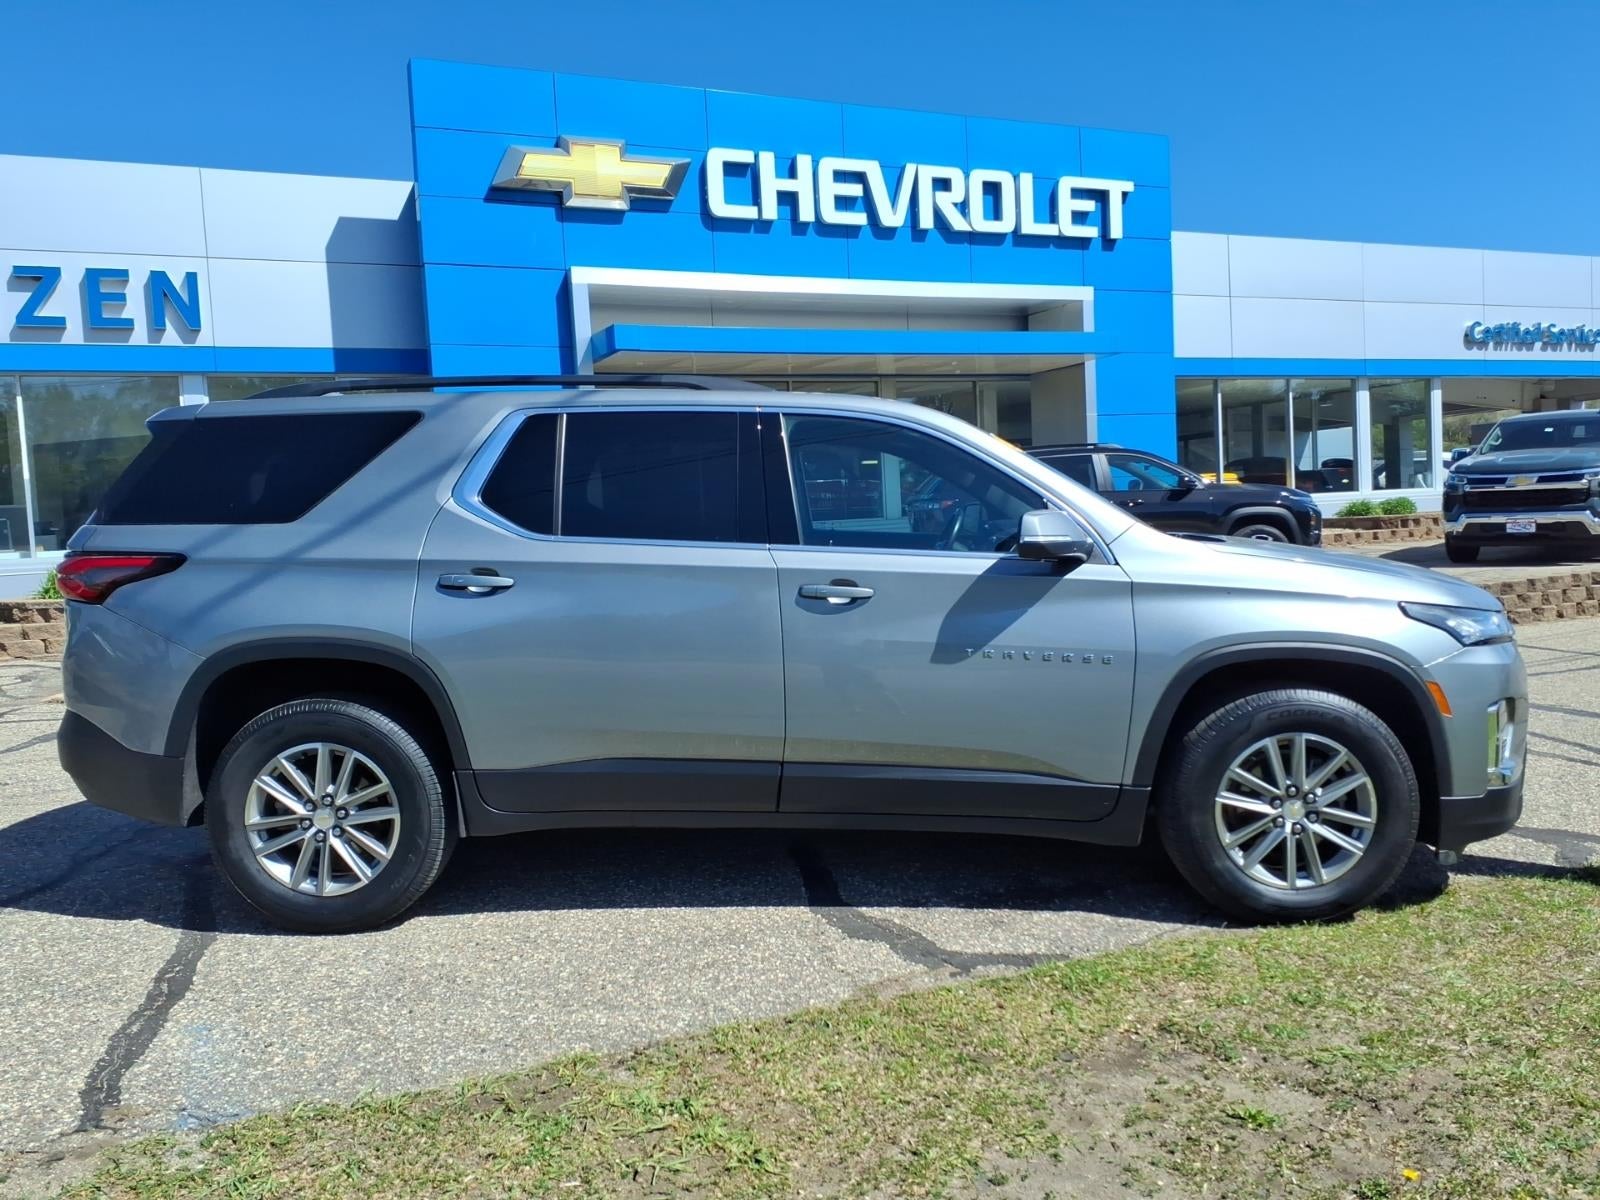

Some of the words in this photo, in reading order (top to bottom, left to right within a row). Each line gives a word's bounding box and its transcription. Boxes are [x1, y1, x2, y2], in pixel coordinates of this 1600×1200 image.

[705, 147, 1135, 240] CHEVROLET
[12, 265, 202, 332] ZEN
[1468, 320, 1541, 344] Certified
[964, 647, 1114, 666] TRAVERSE
